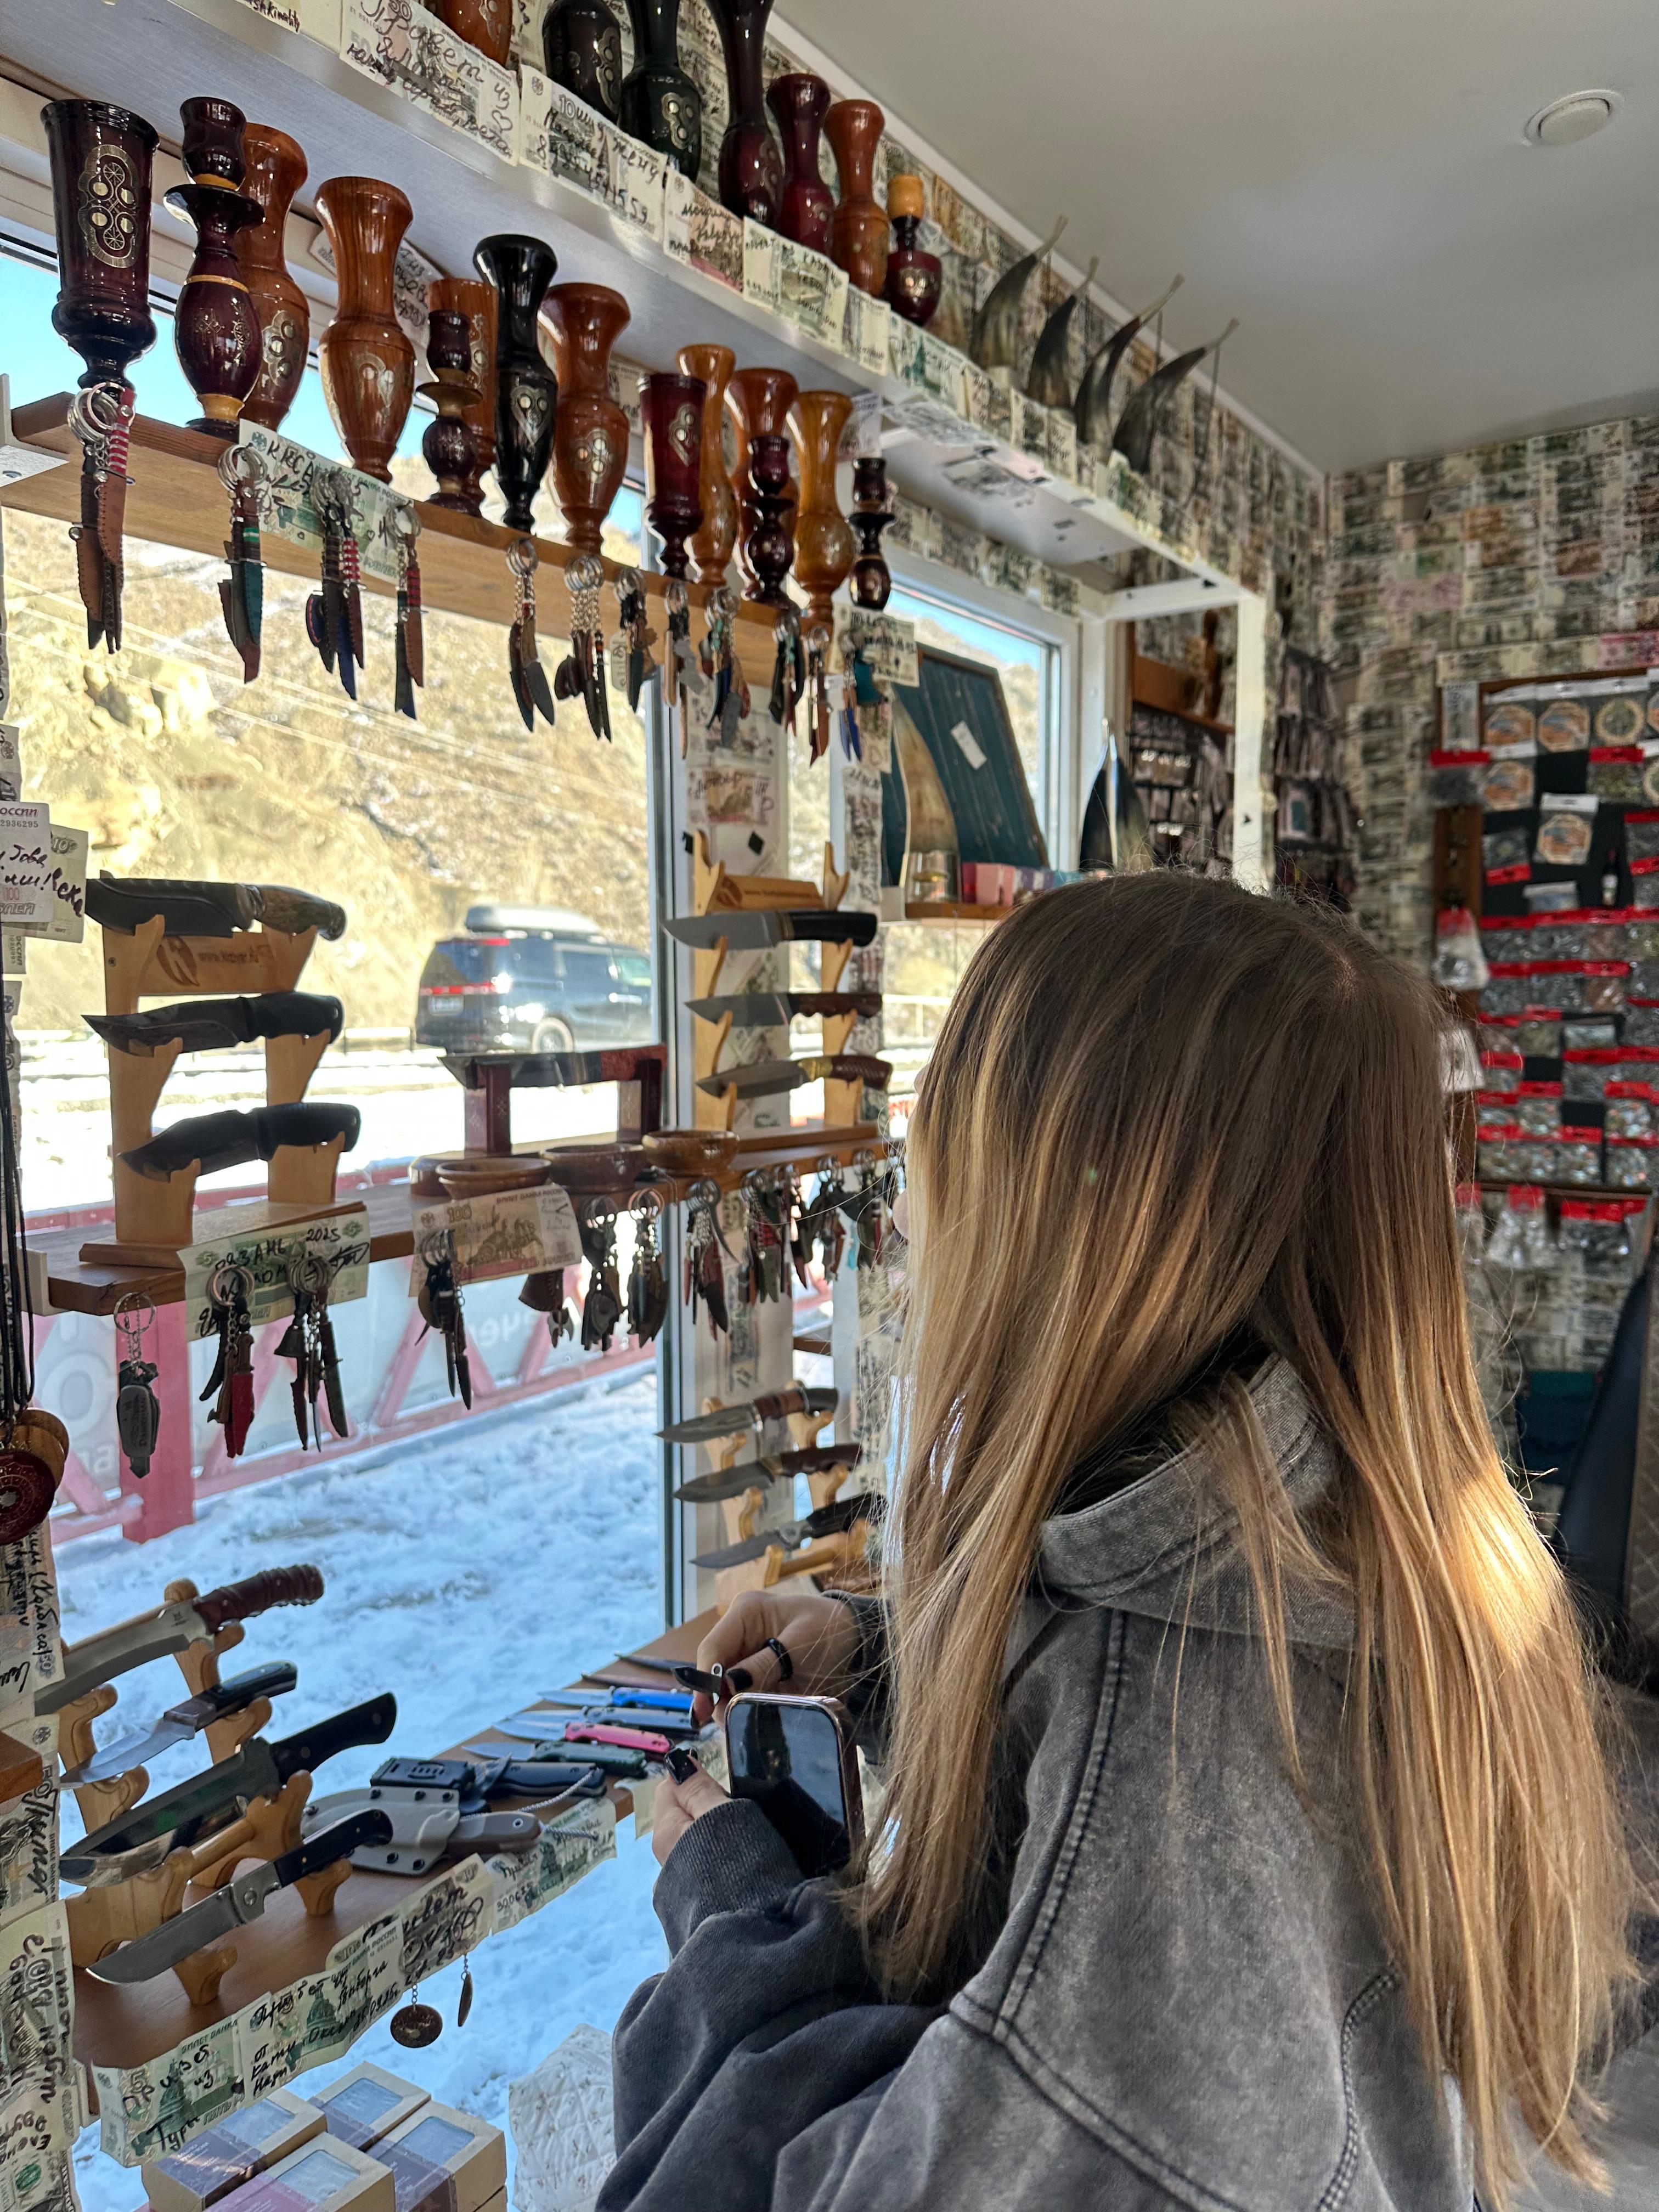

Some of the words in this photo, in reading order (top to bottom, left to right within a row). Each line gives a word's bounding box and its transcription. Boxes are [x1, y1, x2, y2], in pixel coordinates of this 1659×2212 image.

[558, 94, 576, 119] 10
[447, 1204, 472, 1223] 100
[306, 1227, 342, 1242] 2025
